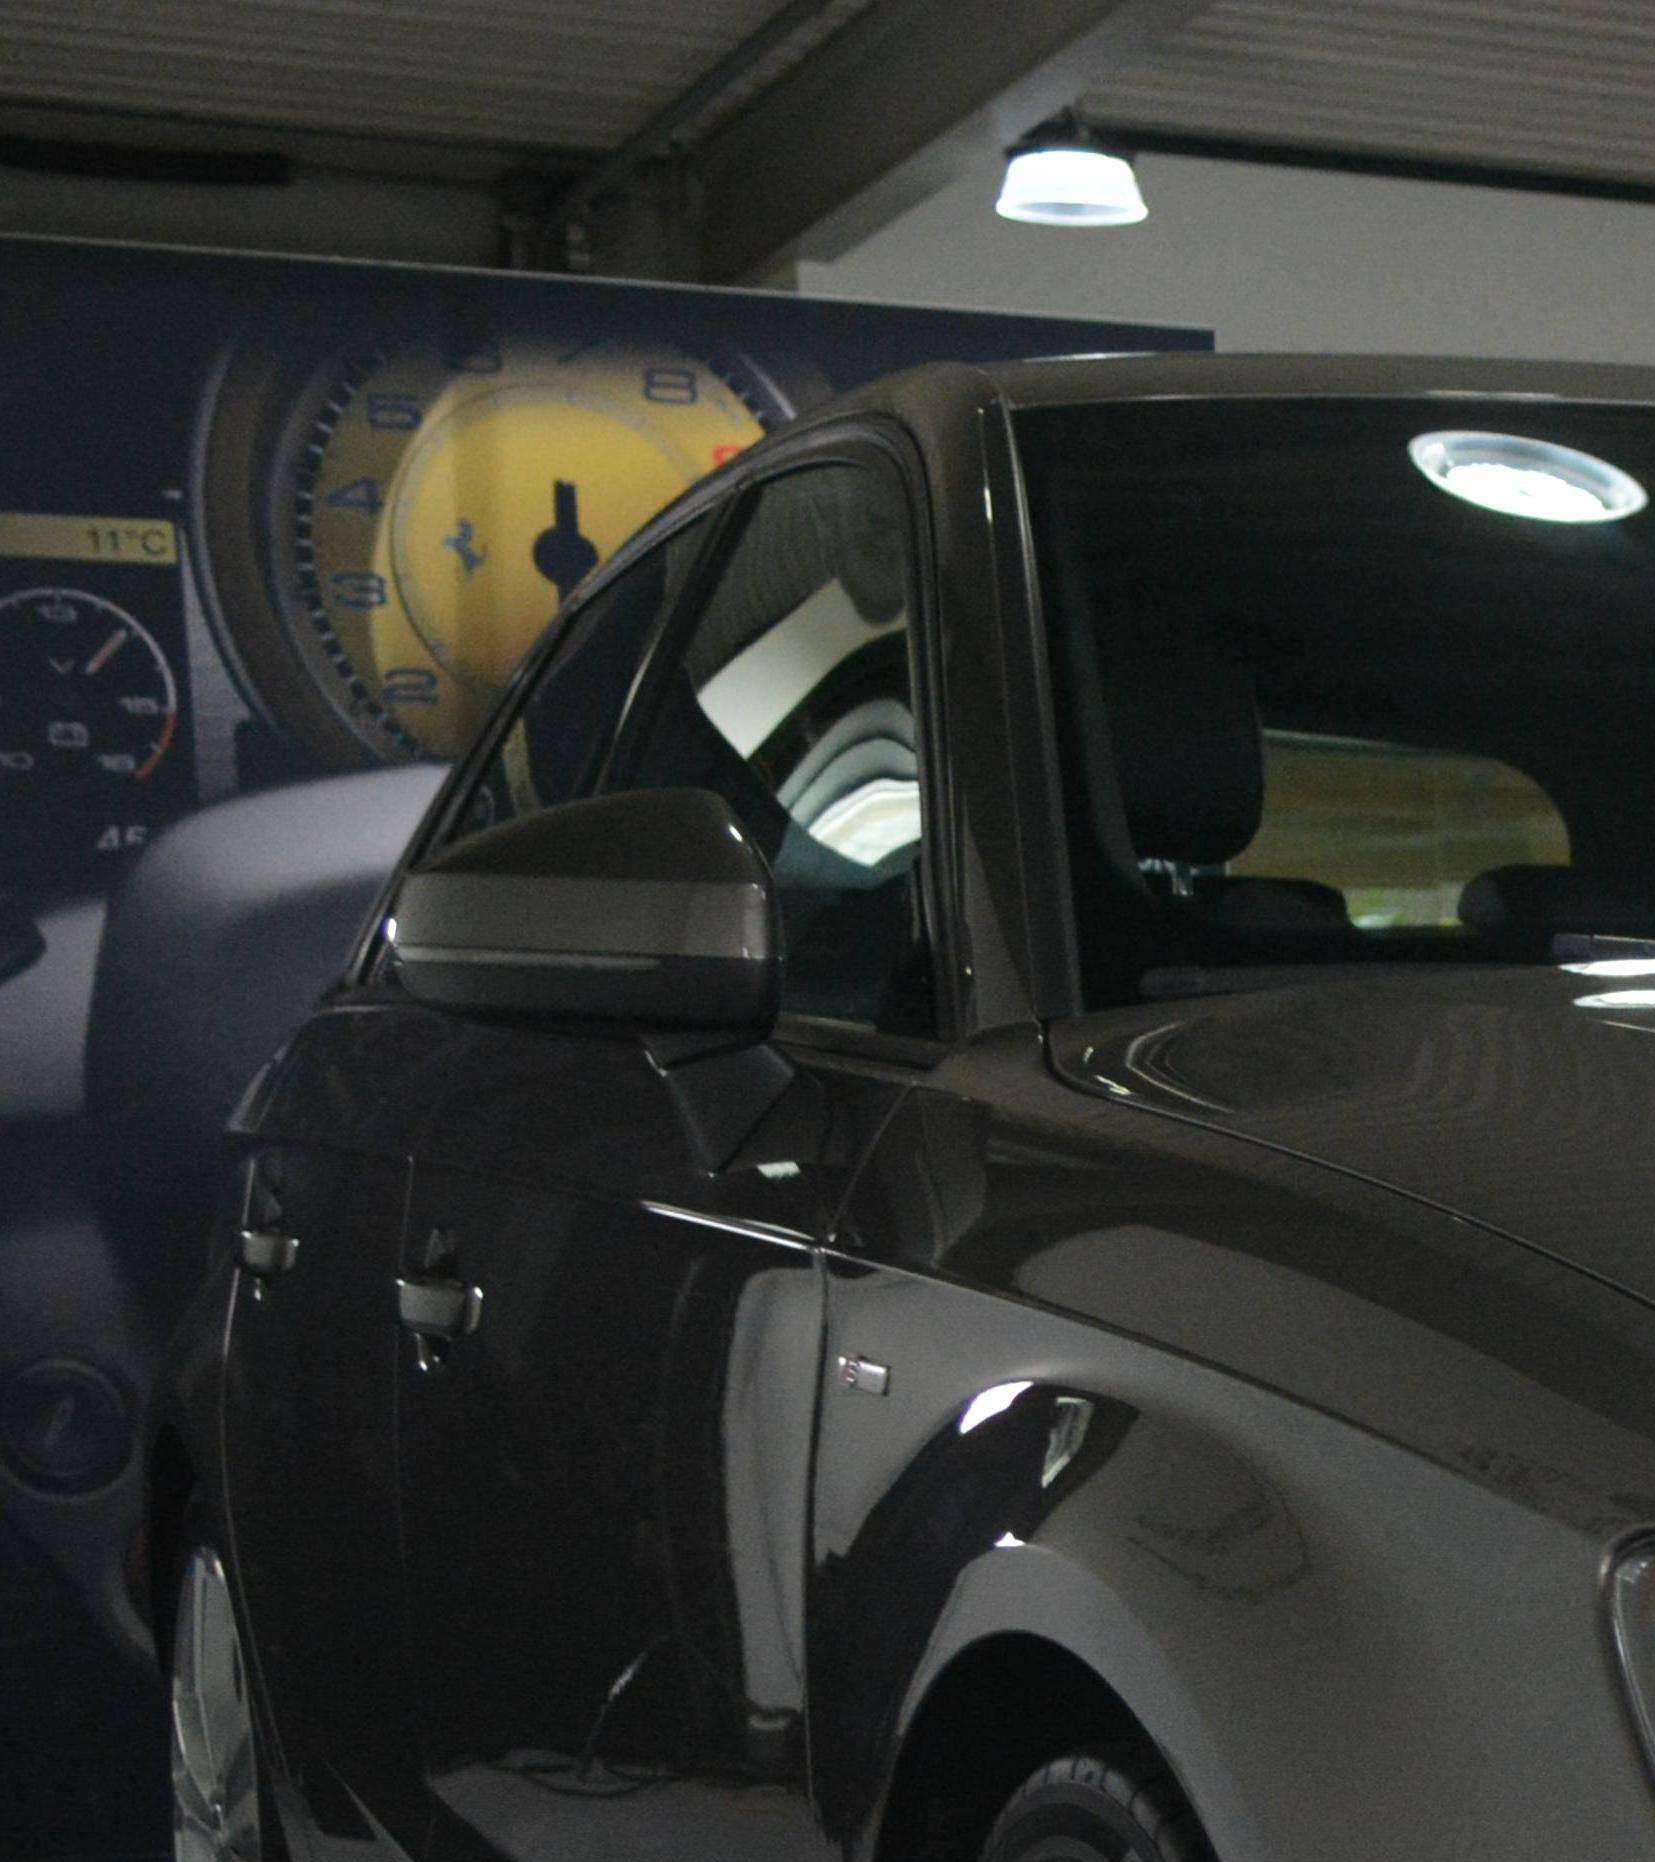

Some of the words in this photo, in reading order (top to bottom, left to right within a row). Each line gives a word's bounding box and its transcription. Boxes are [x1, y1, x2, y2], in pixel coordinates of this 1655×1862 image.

[643, 368, 698, 405] 8
[327, 478, 384, 516] 4
[332, 571, 387, 608] 3
[383, 667, 439, 705] 2
